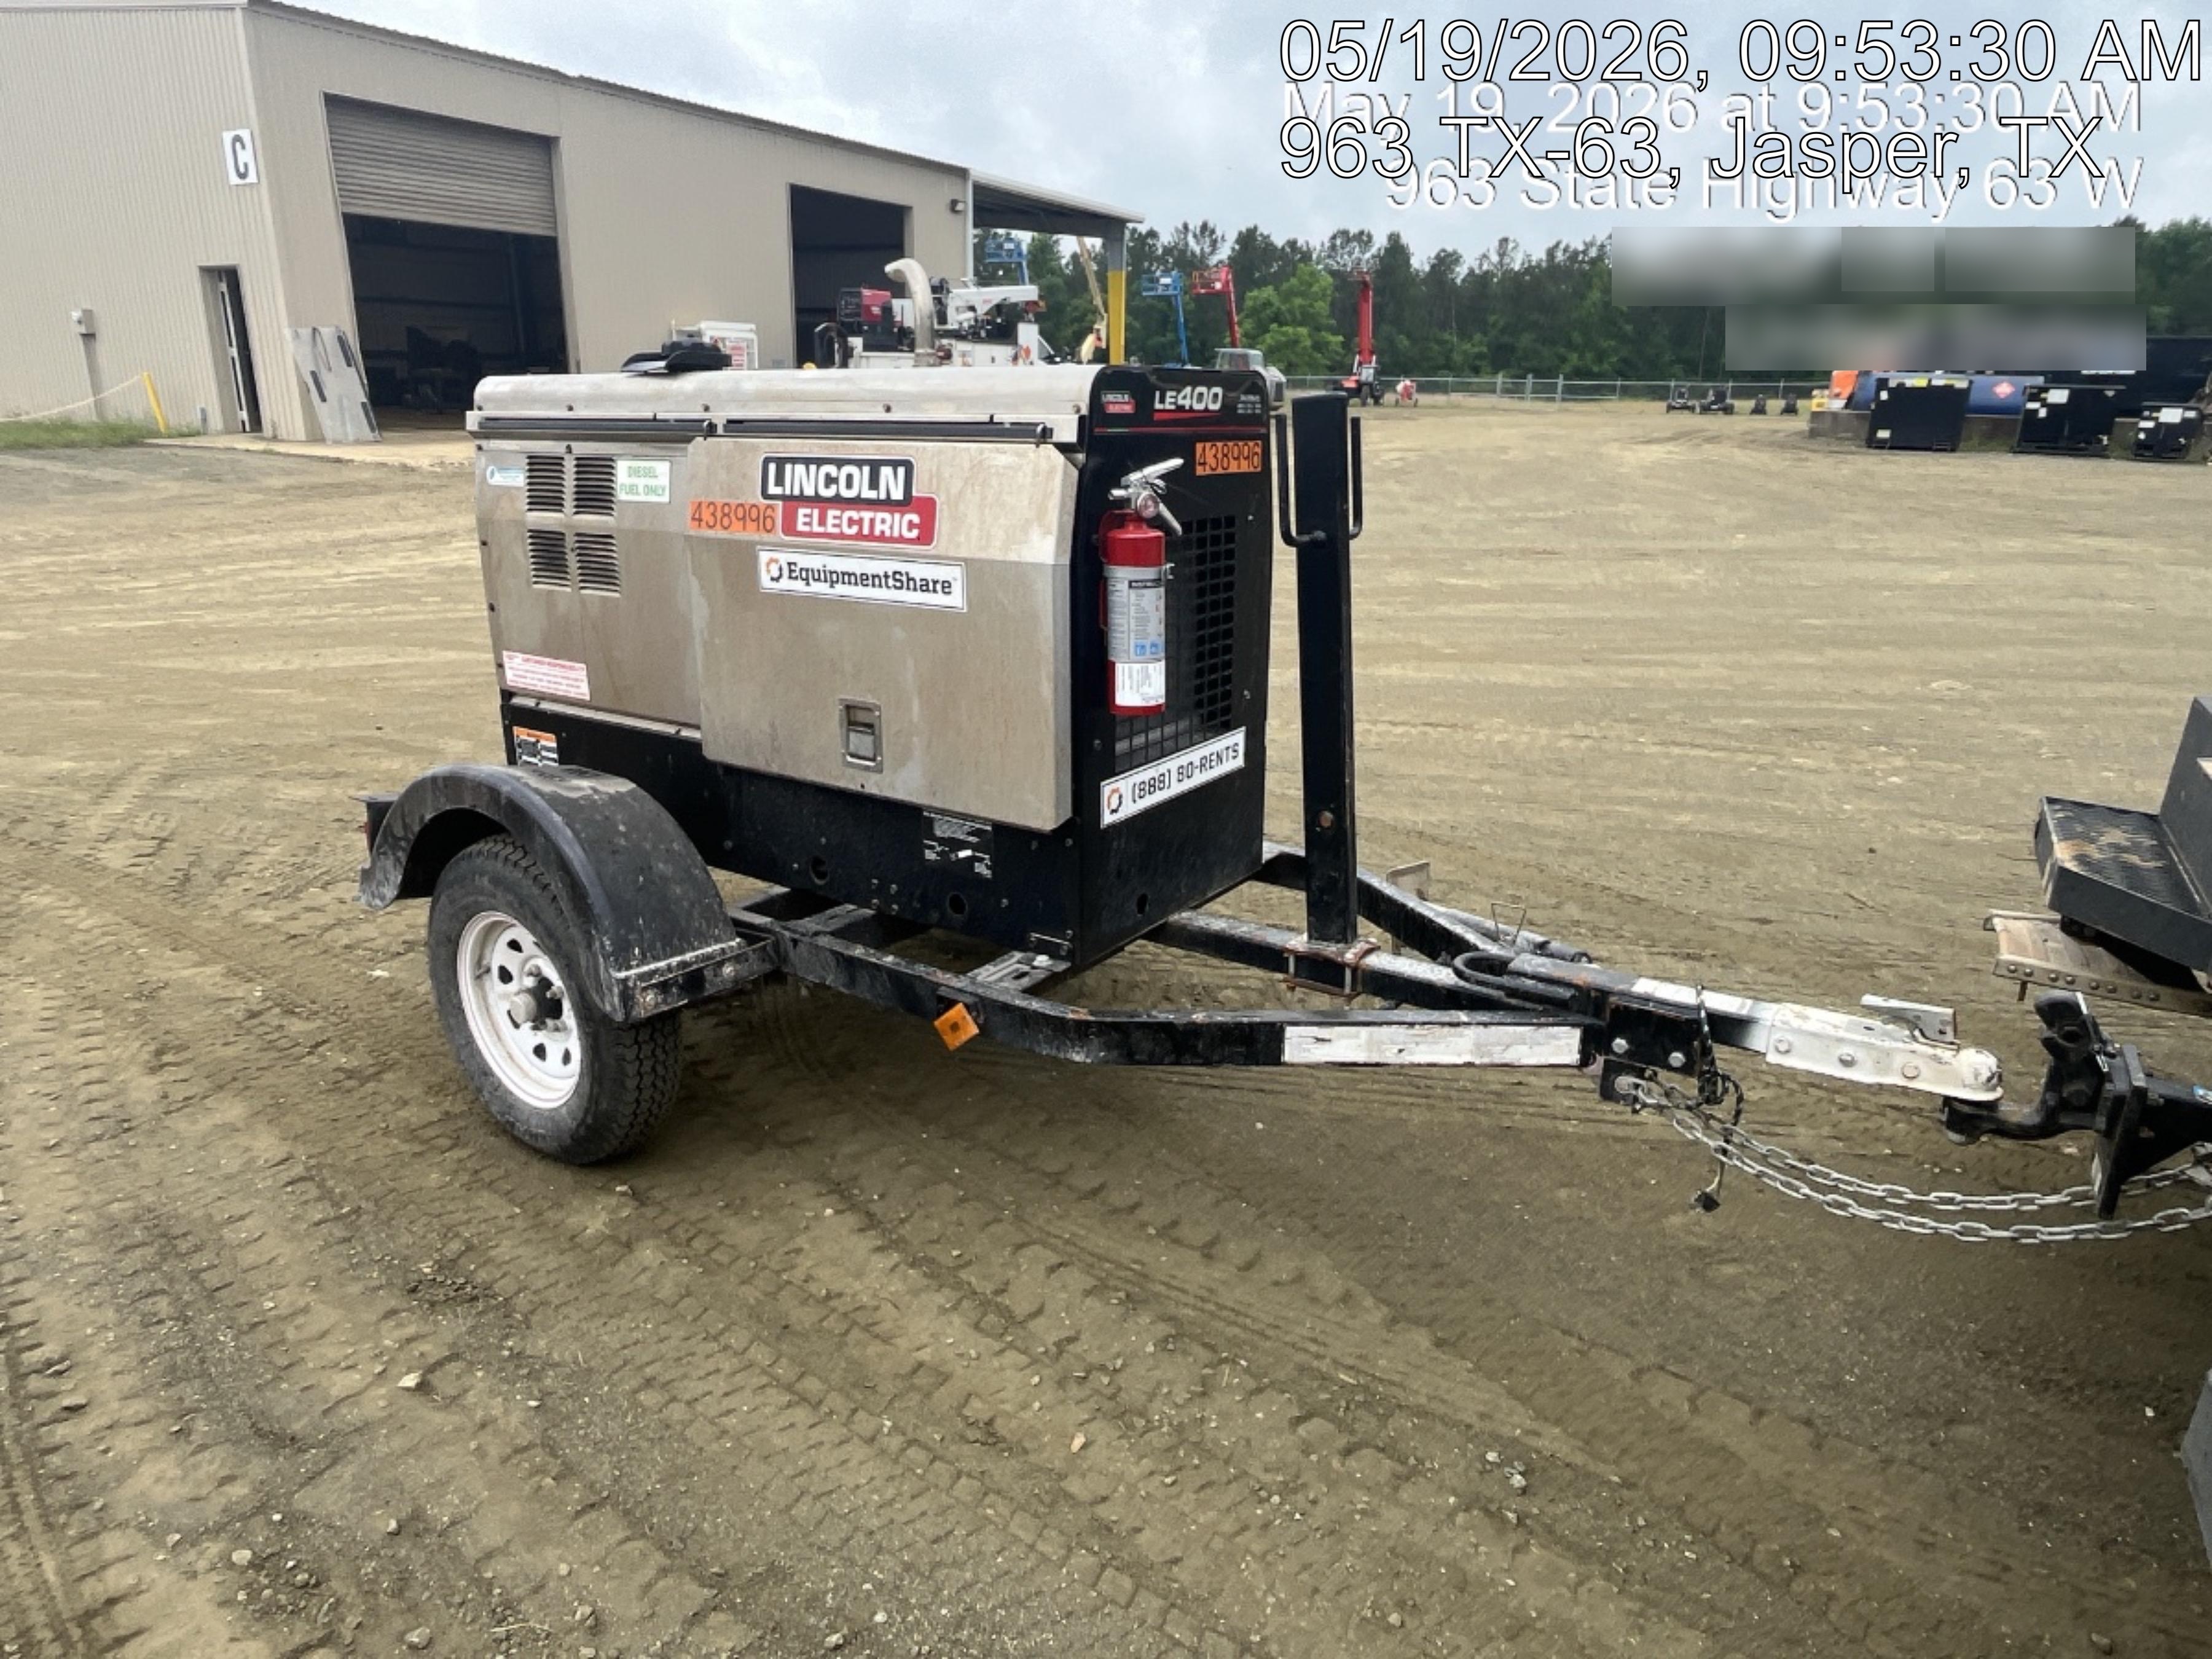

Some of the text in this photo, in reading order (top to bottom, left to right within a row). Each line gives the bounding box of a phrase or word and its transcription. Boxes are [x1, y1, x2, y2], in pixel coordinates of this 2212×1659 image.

[232, 134, 249, 179] C
[1154, 386, 1223, 410] LE400
[627, 466, 659, 479] DIESEL
[1197, 442, 1260, 473] 438996
[619, 484, 666, 497] FUEL ONLY
[767, 462, 906, 501] LINCOLN
[691, 501, 775, 533] 438996
[796, 508, 921, 539] ELECTRIC
[786, 562, 952, 595] EquipmentShare
[1132, 769, 1171, 804] (888)
